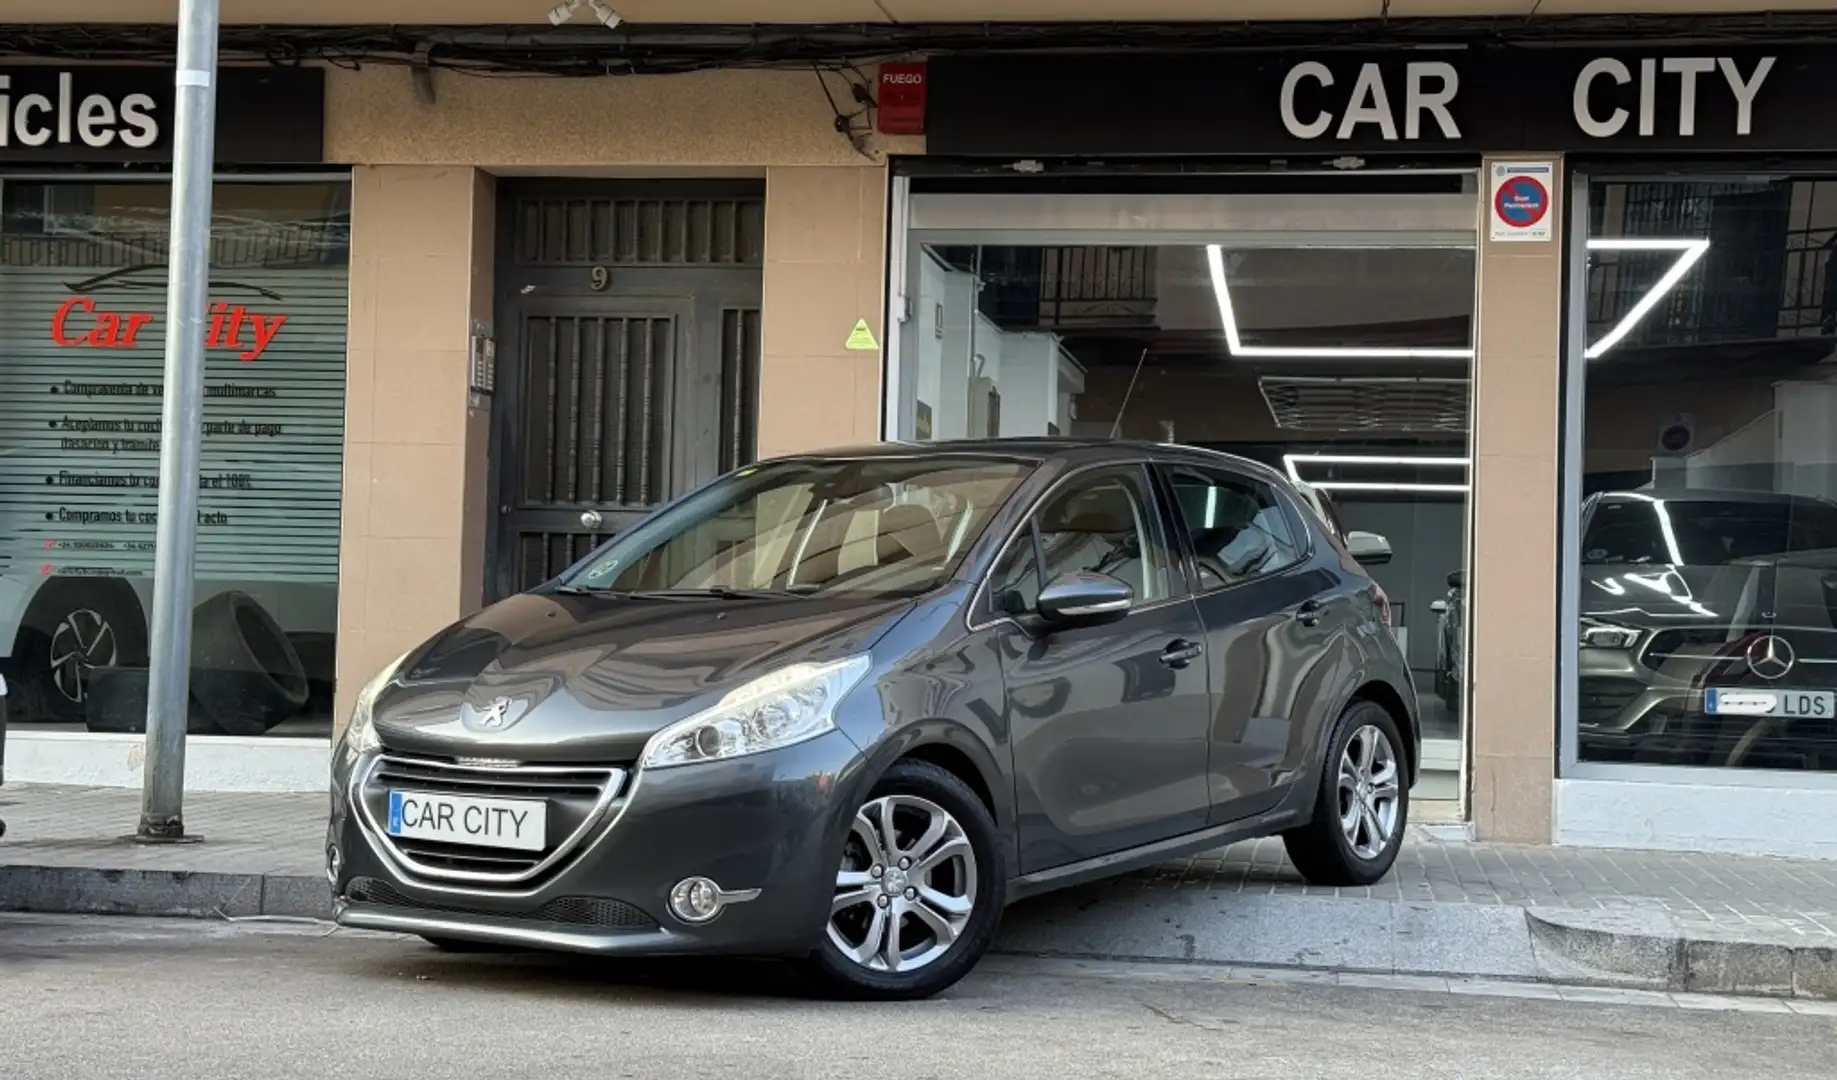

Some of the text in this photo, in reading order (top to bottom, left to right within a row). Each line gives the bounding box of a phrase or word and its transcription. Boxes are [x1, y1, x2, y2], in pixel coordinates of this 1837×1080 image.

[882, 73, 922, 85] FUEGO
[1280, 56, 1777, 140] CAR CITY
[0, 72, 159, 148] icles
[591, 266, 609, 291] 9
[50, 296, 288, 360] Car ity
[204, 383, 277, 398] multimarcas
[61, 414, 121, 433] Aceptamos
[124, 418, 135, 432] tu
[138, 418, 163, 433] coch
[206, 420, 235, 437] parte
[255, 424, 281, 438] pago
[111, 440, 119, 454] y
[59, 470, 127, 488] Financiamos
[129, 472, 139, 487] tu
[211, 473, 222, 489] el
[226, 473, 253, 490] 100%
[59, 506, 122, 525] Compramos
[126, 509, 137, 521] tu
[204, 511, 228, 524] acto
[1784, 694, 1826, 716] LDS
[401, 799, 455, 832] CAR
[464, 805, 529, 838] CITY
